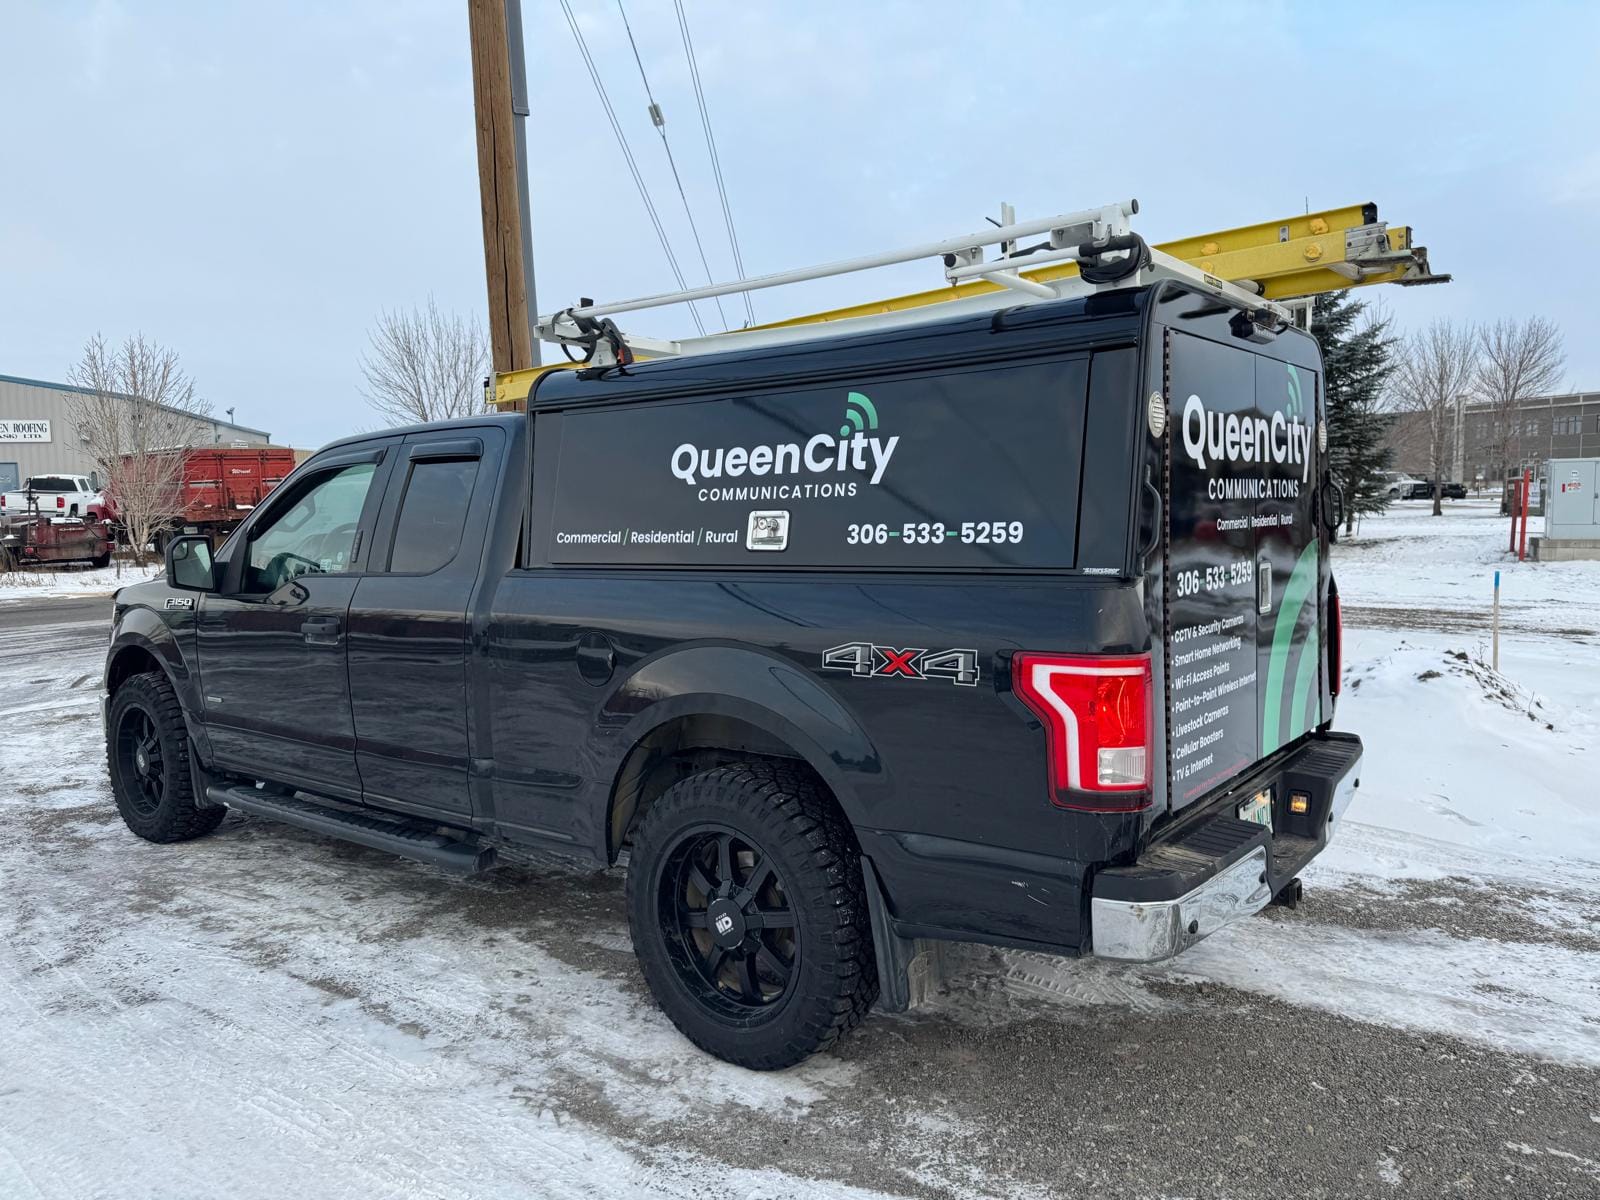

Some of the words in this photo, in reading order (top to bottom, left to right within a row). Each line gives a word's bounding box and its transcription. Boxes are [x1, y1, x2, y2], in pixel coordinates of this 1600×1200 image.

[13, 422, 48, 433] ROOFING
[698, 482, 858, 502] COMMUNICATIONS
[1208, 477, 1299, 500] COMMUNICATIONS
[847, 521, 1024, 545] 306-533-5259
[1216, 515, 1249, 531] Commercial
[1251, 513, 1278, 528] Residential
[1280, 512, 1293, 526] Rural
[556, 530, 621, 544] Commercial
[630, 529, 695, 544] Residential
[705, 529, 739, 543] Rural
[1176, 560, 1252, 597] 306-533-5259
[1174, 627, 1192, 643] CCTV
[1192, 626, 1198, 638] &
[1198, 619, 1221, 635] Security
[1221, 615, 1244, 629] Cameras
[1175, 650, 1194, 667] Smart
[1194, 646, 1211, 661] Home
[1212, 635, 1241, 655] Networking
[1175, 672, 1192, 690] Wi-Fi
[1192, 668, 1213, 685] Access
[1213, 661, 1230, 677] Points
[1175, 686, 1217, 714] Point-to-Point
[1217, 679, 1239, 697] Wireless
[1176, 714, 1203, 738] Livestock
[1203, 705, 1229, 725] Cameras
[1176, 739, 1200, 760] Cellular
[1200, 728, 1224, 749] Boosters
[1176, 767, 1184, 782] TV
[1184, 764, 1190, 777] &
[1190, 752, 1213, 775] Internet
